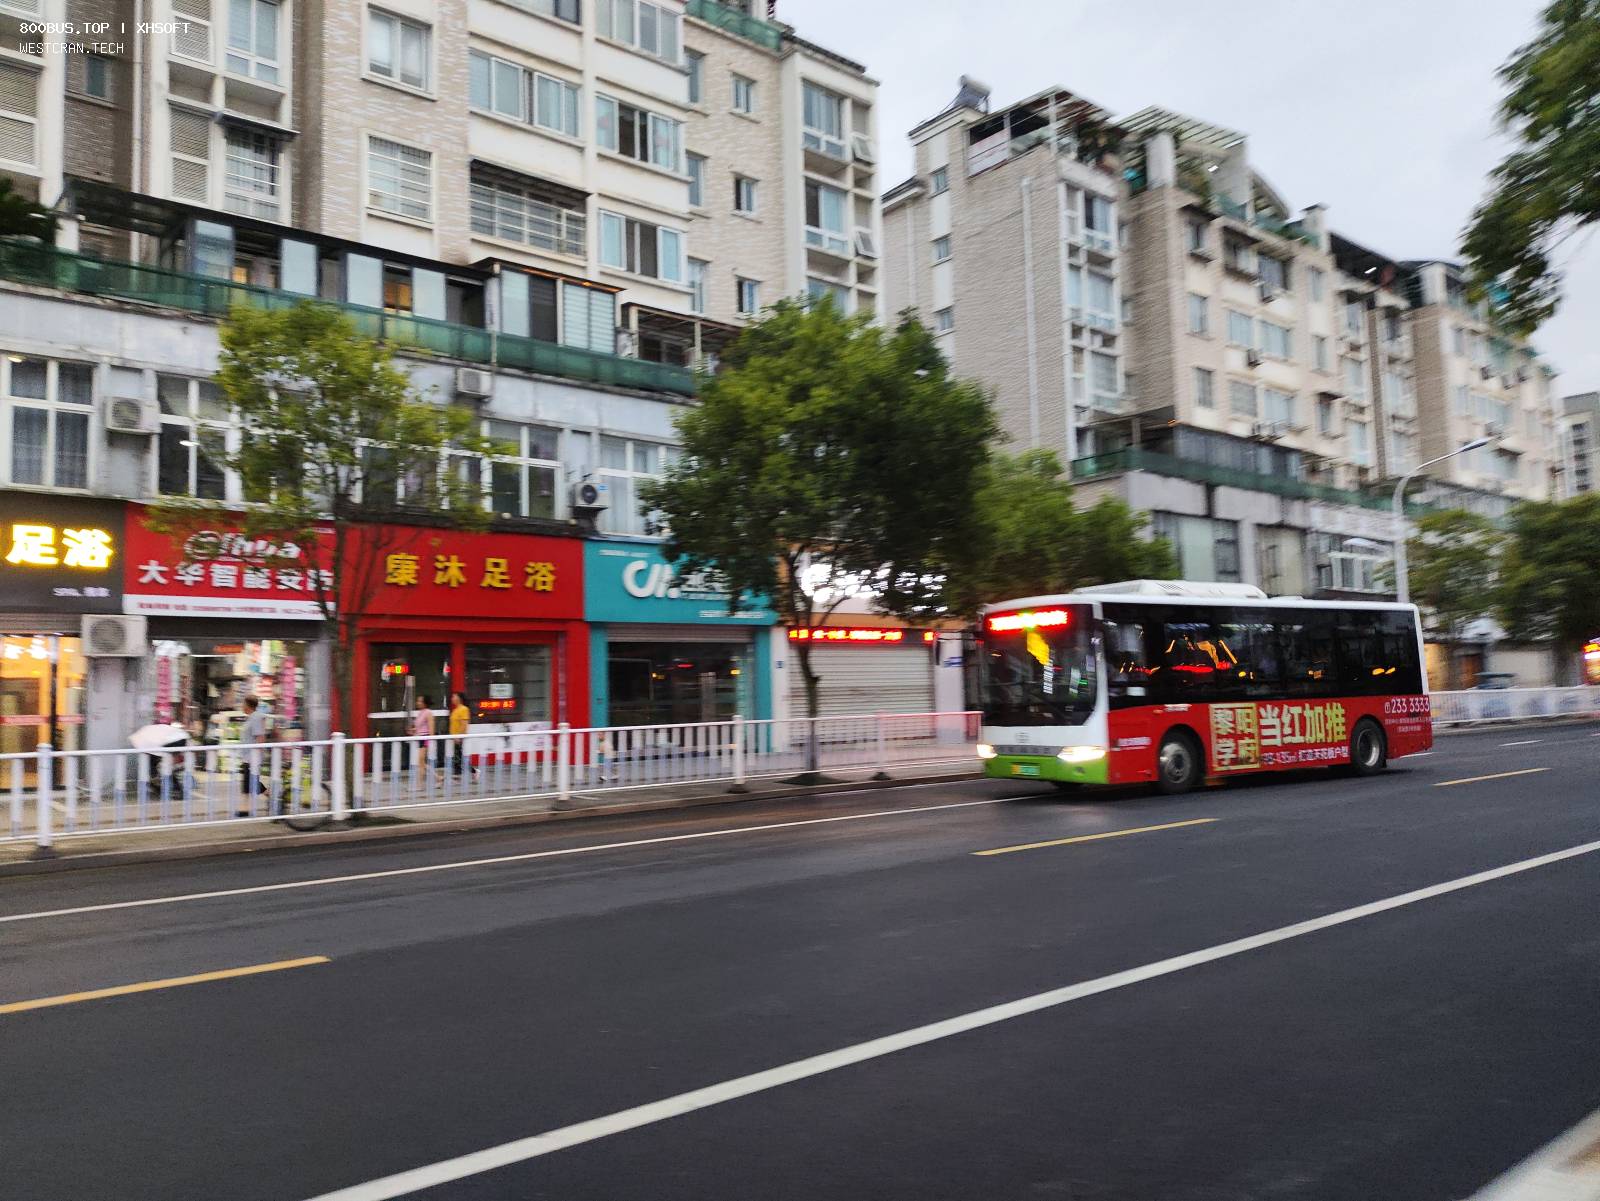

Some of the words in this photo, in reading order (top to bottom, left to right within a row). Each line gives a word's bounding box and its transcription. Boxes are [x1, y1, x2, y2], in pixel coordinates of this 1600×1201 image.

[5, 525, 113, 567] 足浴
[385, 552, 556, 591] 康沐足浴
[1259, 702, 1347, 747] 当红加推
[1391, 698, 1407, 713] 233
[1409, 697, 1430, 712] 3333
